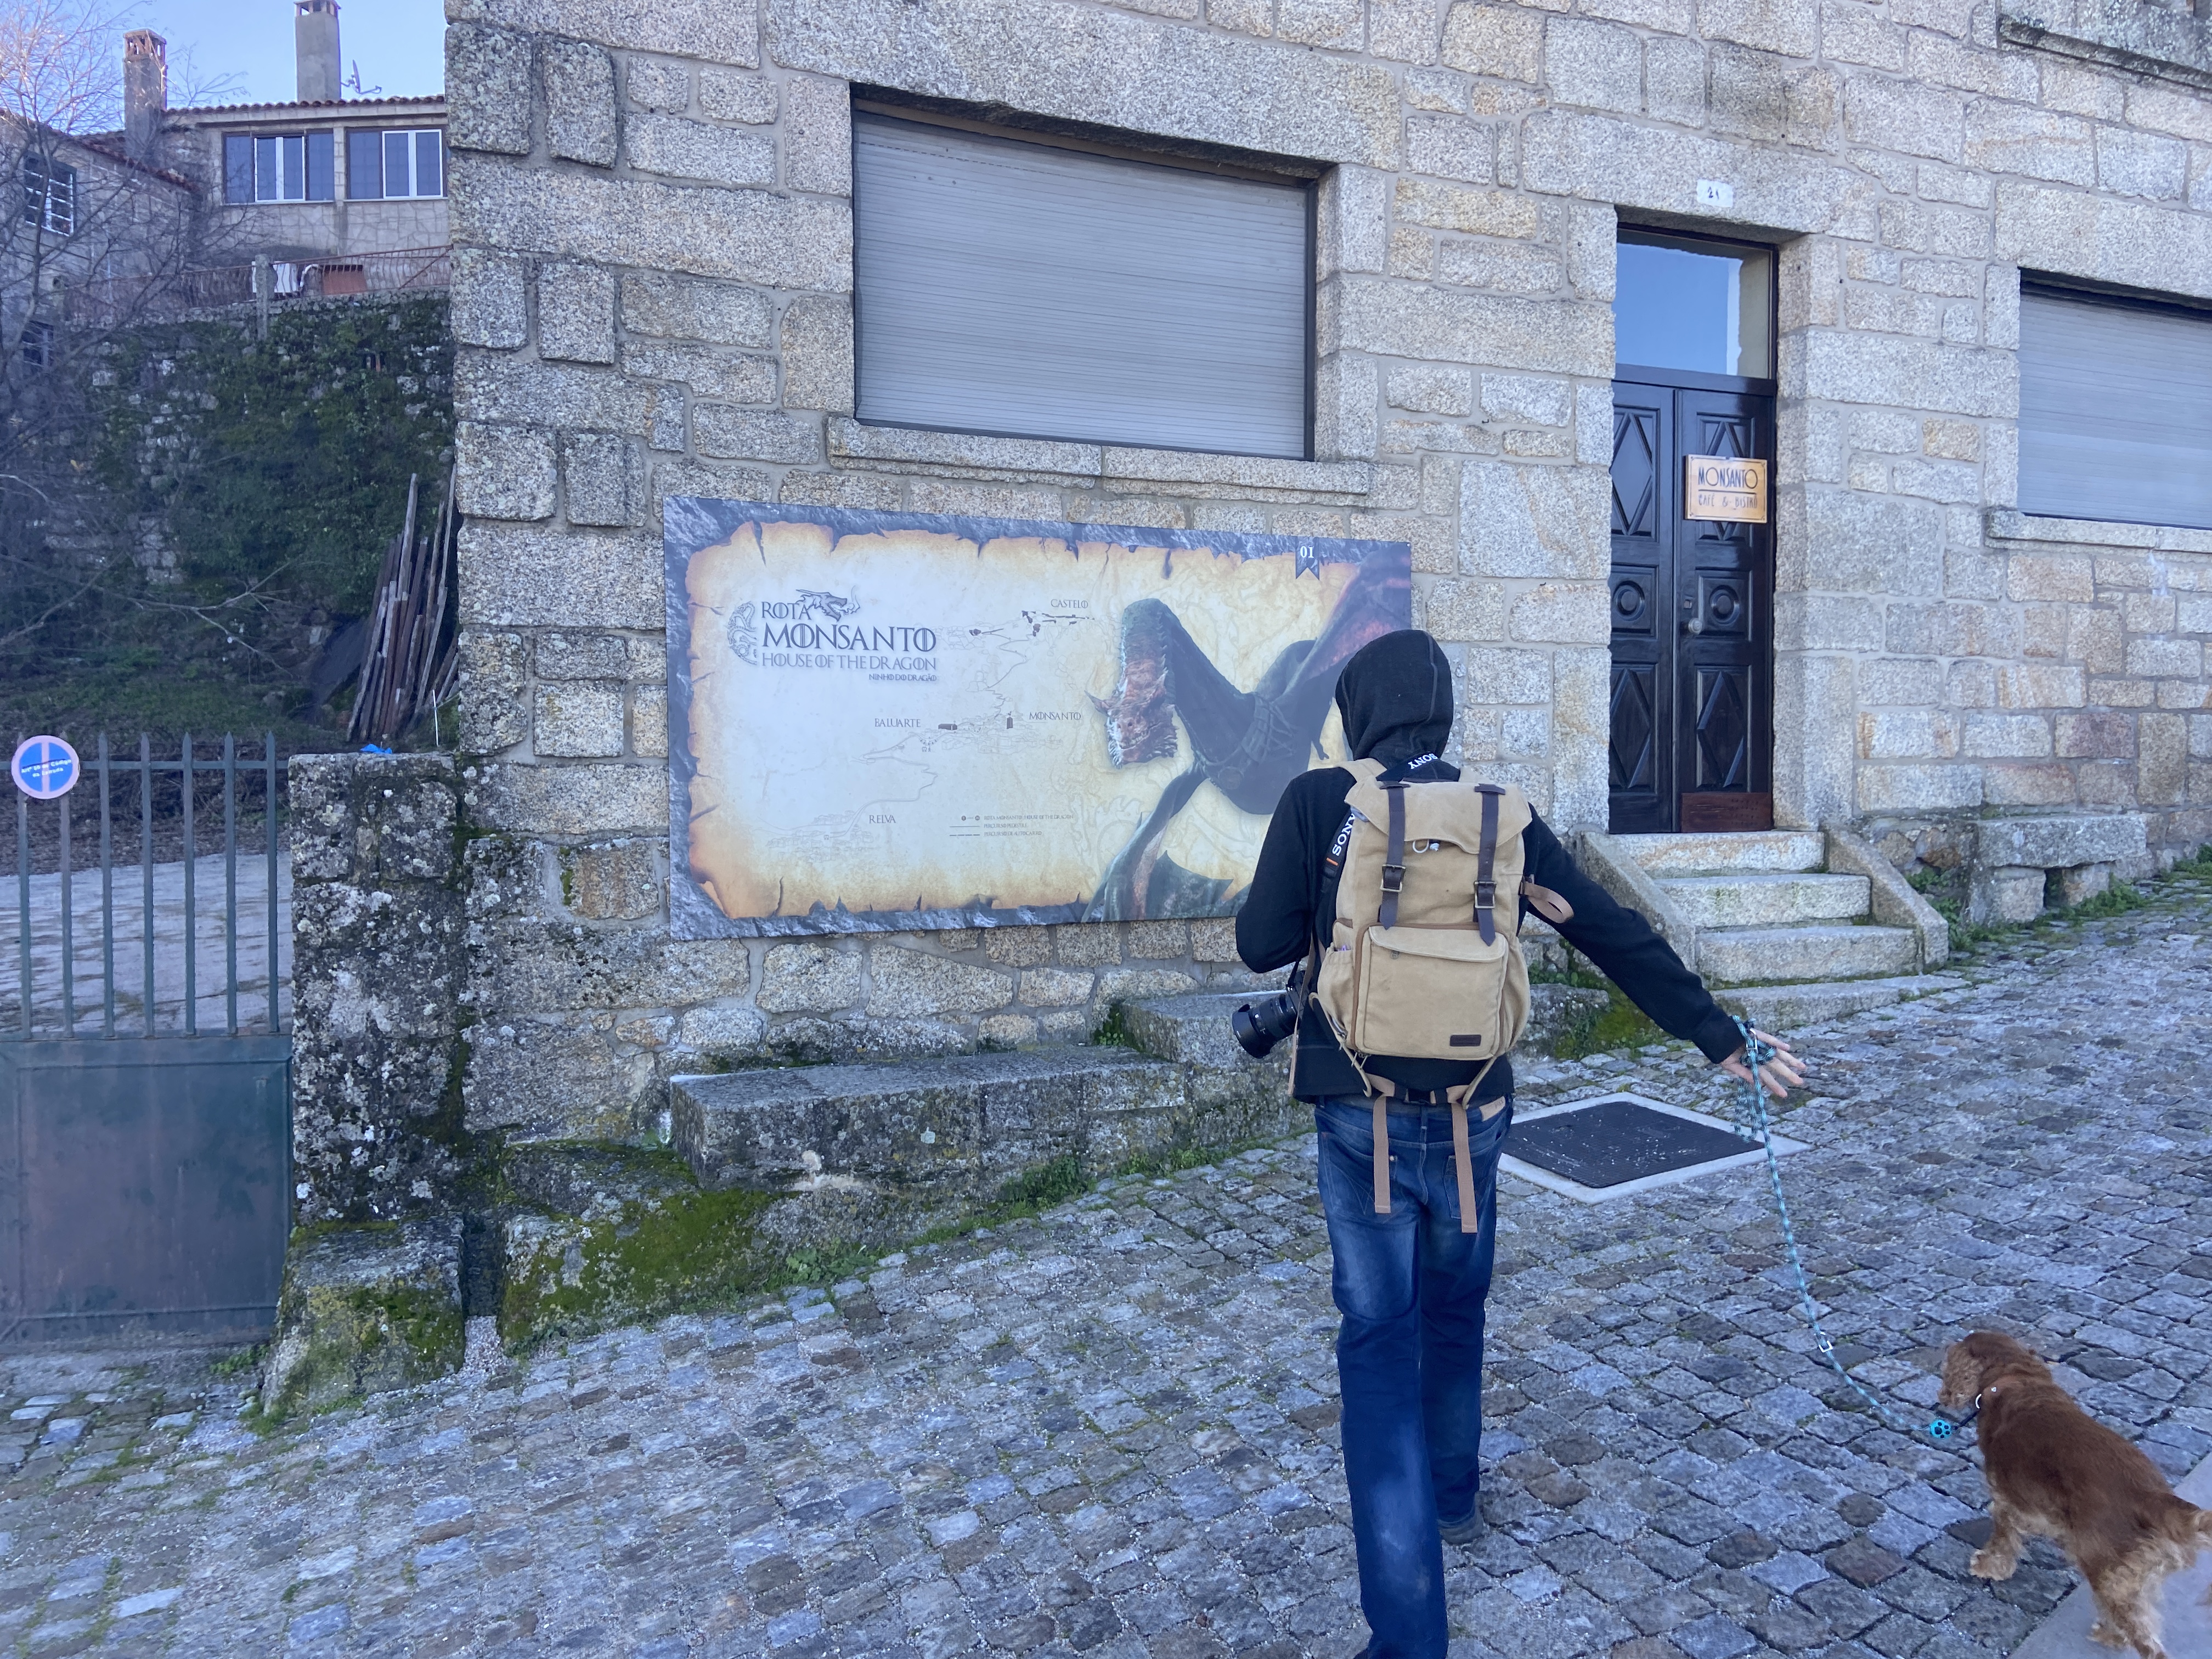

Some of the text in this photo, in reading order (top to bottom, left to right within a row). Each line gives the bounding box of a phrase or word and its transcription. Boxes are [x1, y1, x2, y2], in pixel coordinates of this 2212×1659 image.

[1698, 467, 1758, 489] MONSANTO
[1300, 546, 1314, 558] 01
[761, 601, 812, 620] ROTA
[1051, 599, 1088, 610] CASTELO
[762, 622, 936, 652] MONSANTO
[762, 653, 936, 670] HOUSE OF THE DRAGON
[874, 718, 921, 727] BALUARTE
[1029, 712, 1081, 721] MONSANTO
[1408, 753, 1438, 769] SONY
[869, 814, 896, 823] RELVA
